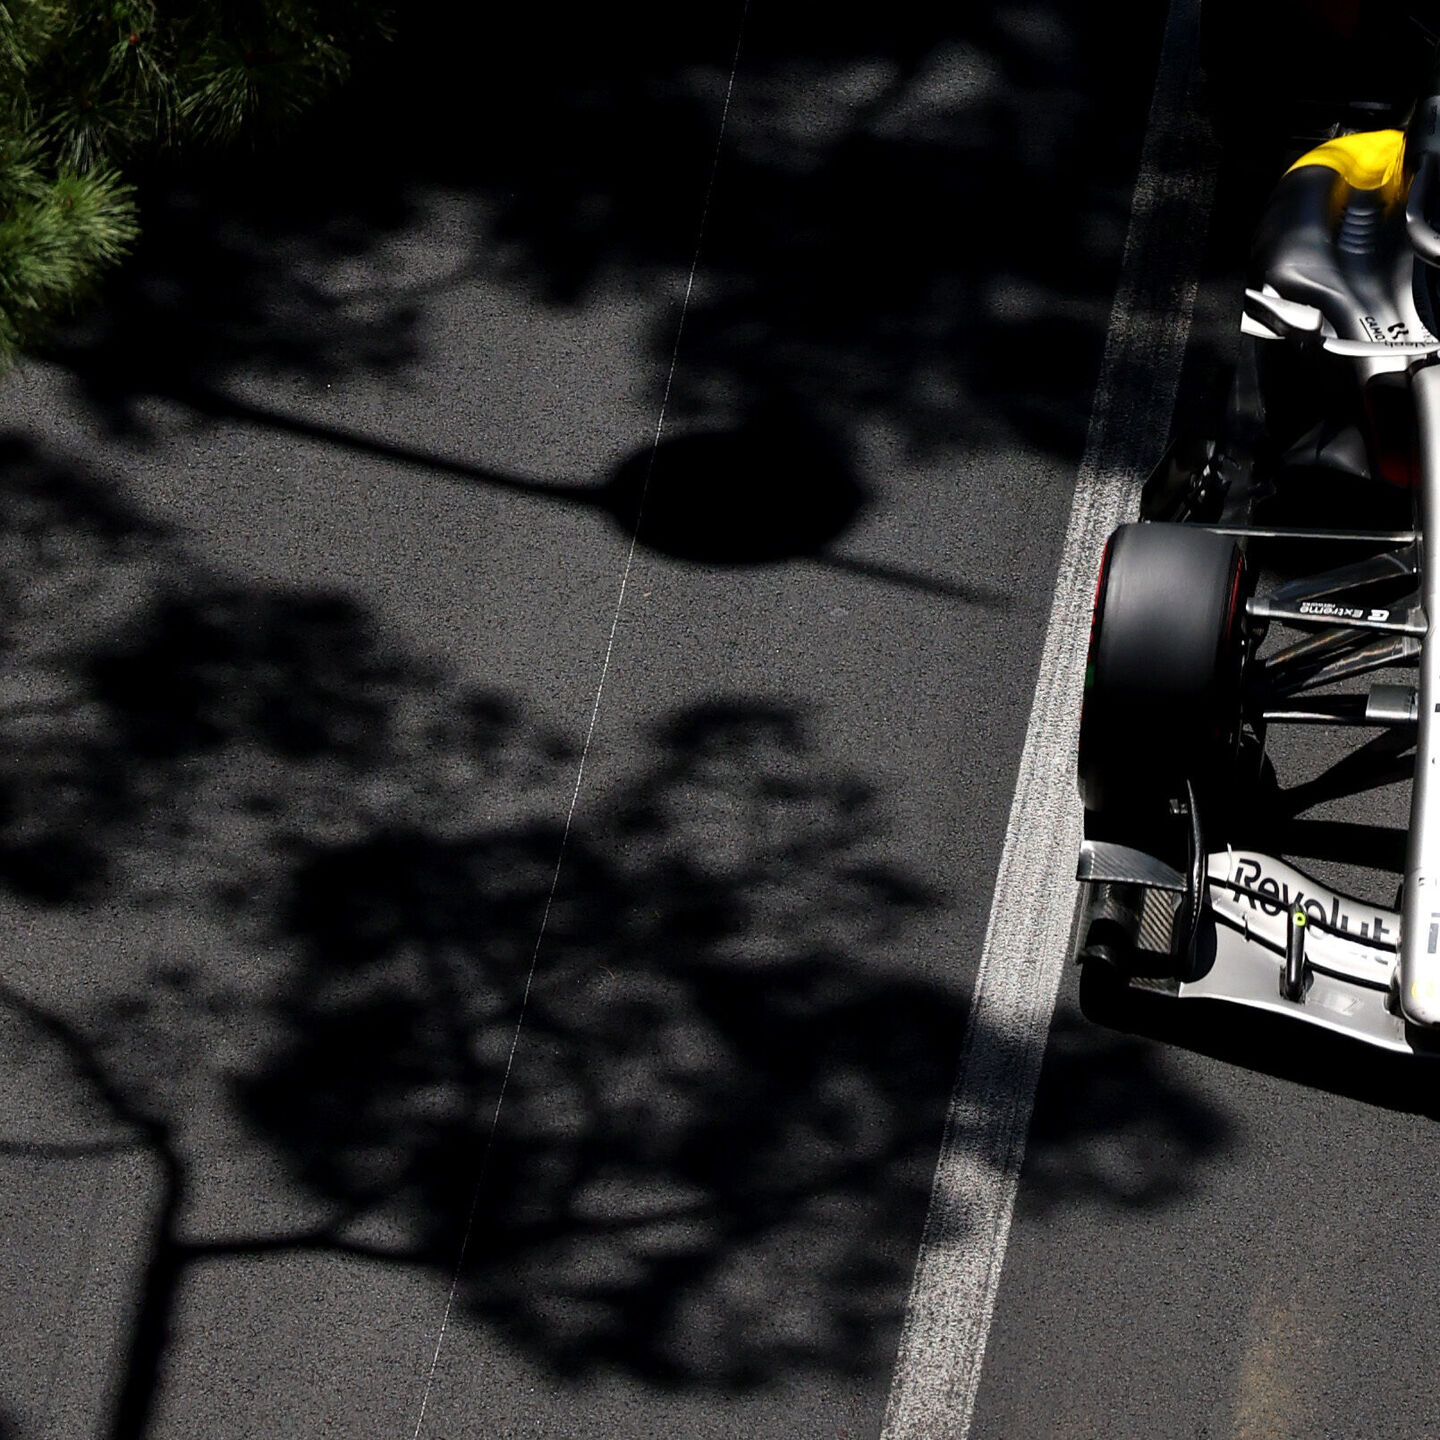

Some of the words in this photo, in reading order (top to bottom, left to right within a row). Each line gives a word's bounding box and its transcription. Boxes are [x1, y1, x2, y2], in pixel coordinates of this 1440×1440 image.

[1365, 316, 1386, 341] CAMO
[1300, 606, 1364, 619] Extreme
[1233, 857, 1391, 960] Revolut
